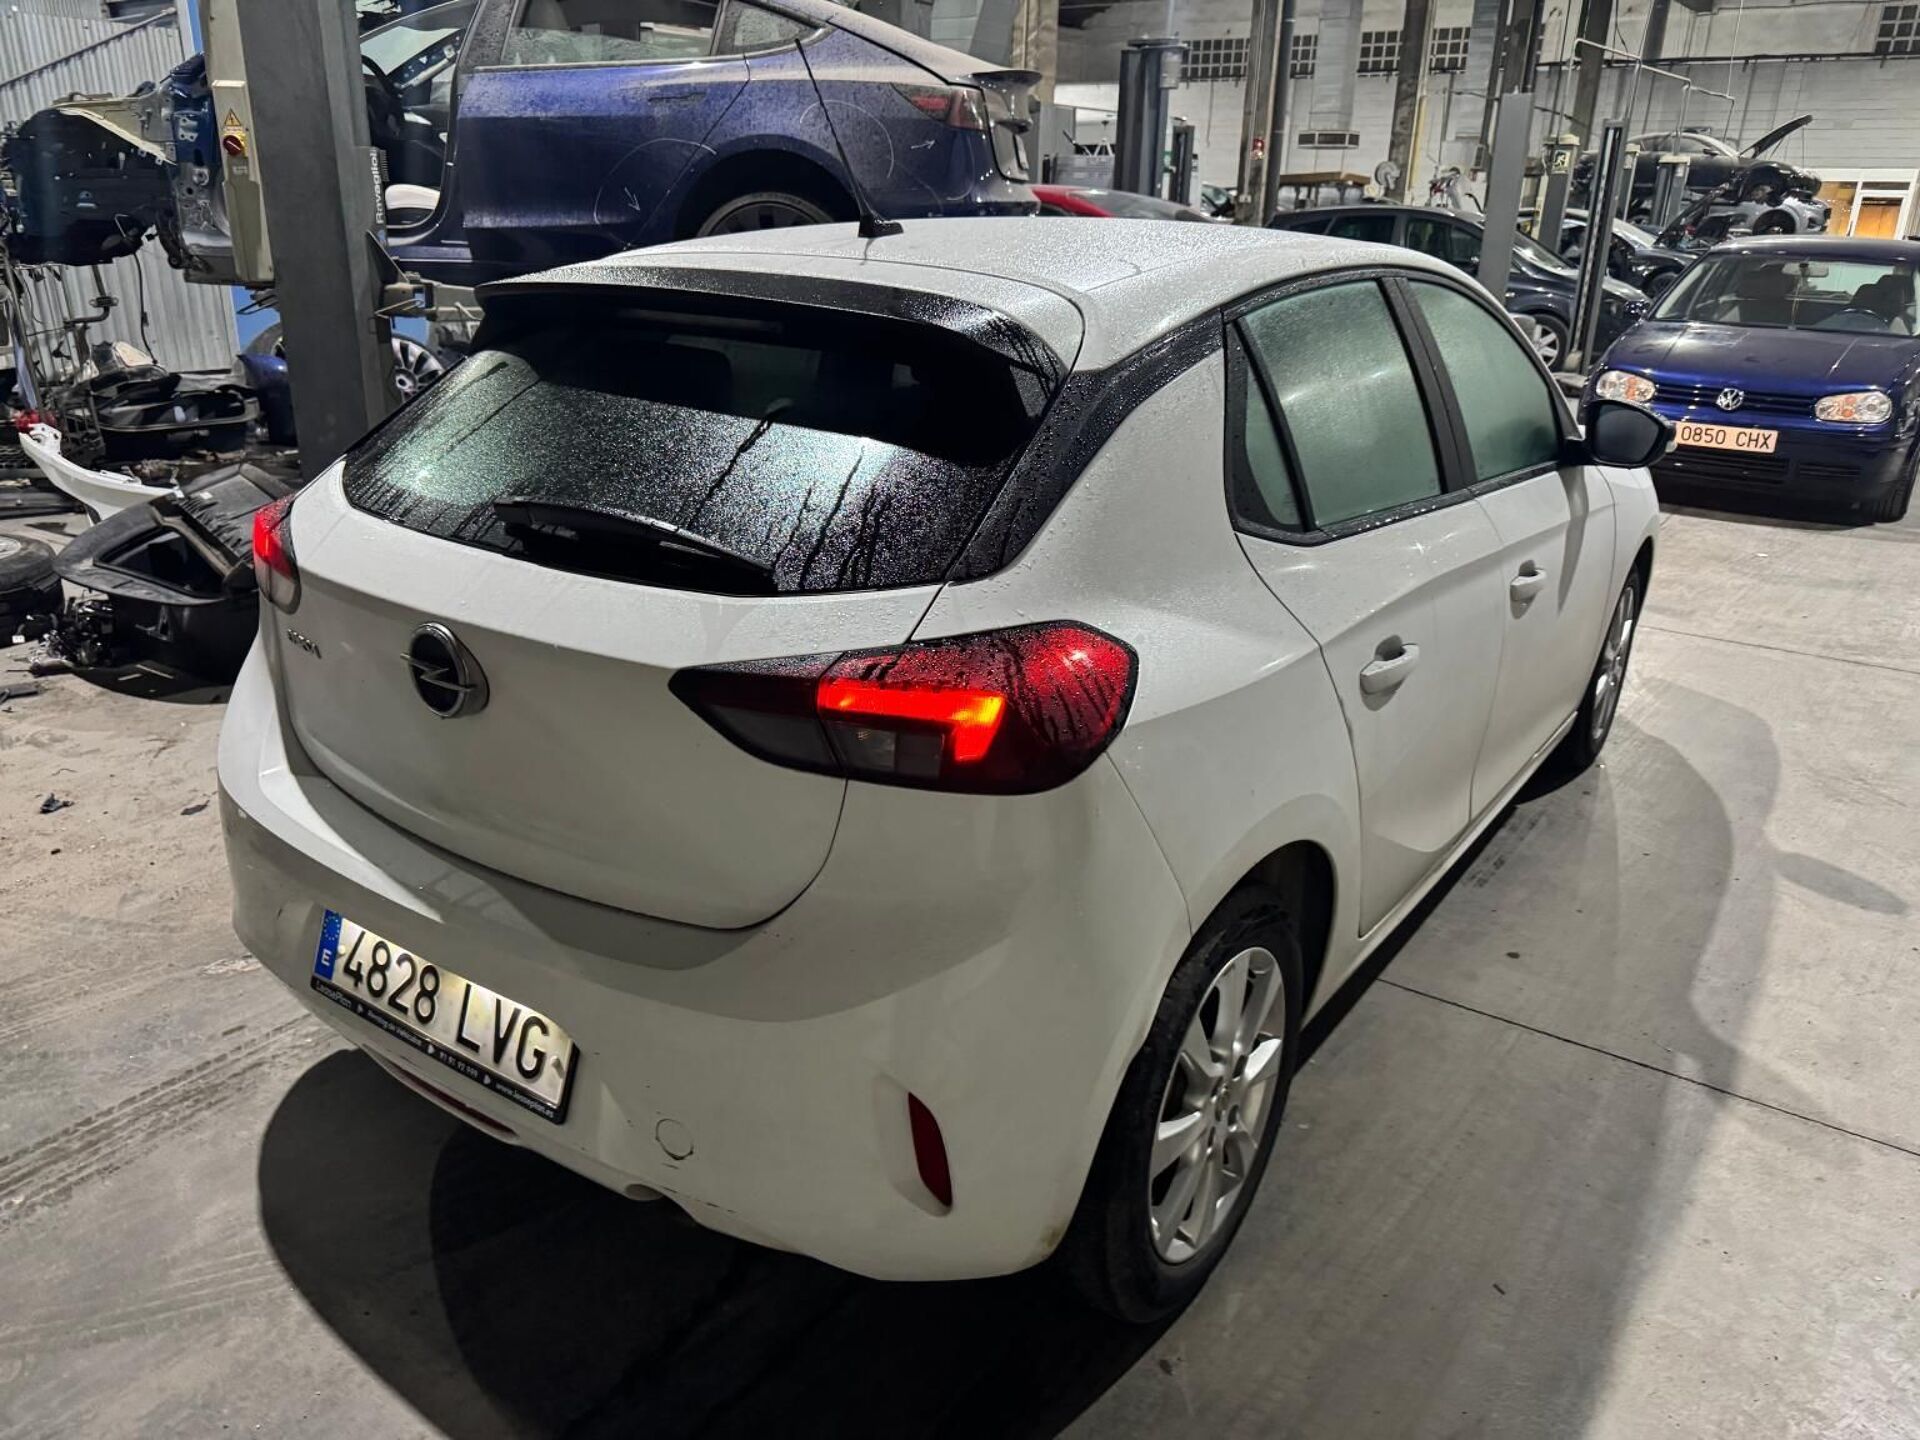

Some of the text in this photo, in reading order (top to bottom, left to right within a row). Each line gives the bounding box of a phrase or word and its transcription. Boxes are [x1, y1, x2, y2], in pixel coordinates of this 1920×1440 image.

[369, 147, 384, 225] Ravaglioli
[1680, 425, 1773, 450] 0850 CHX
[320, 948, 333, 967] E
[342, 930, 550, 1080] 4828 LVG
